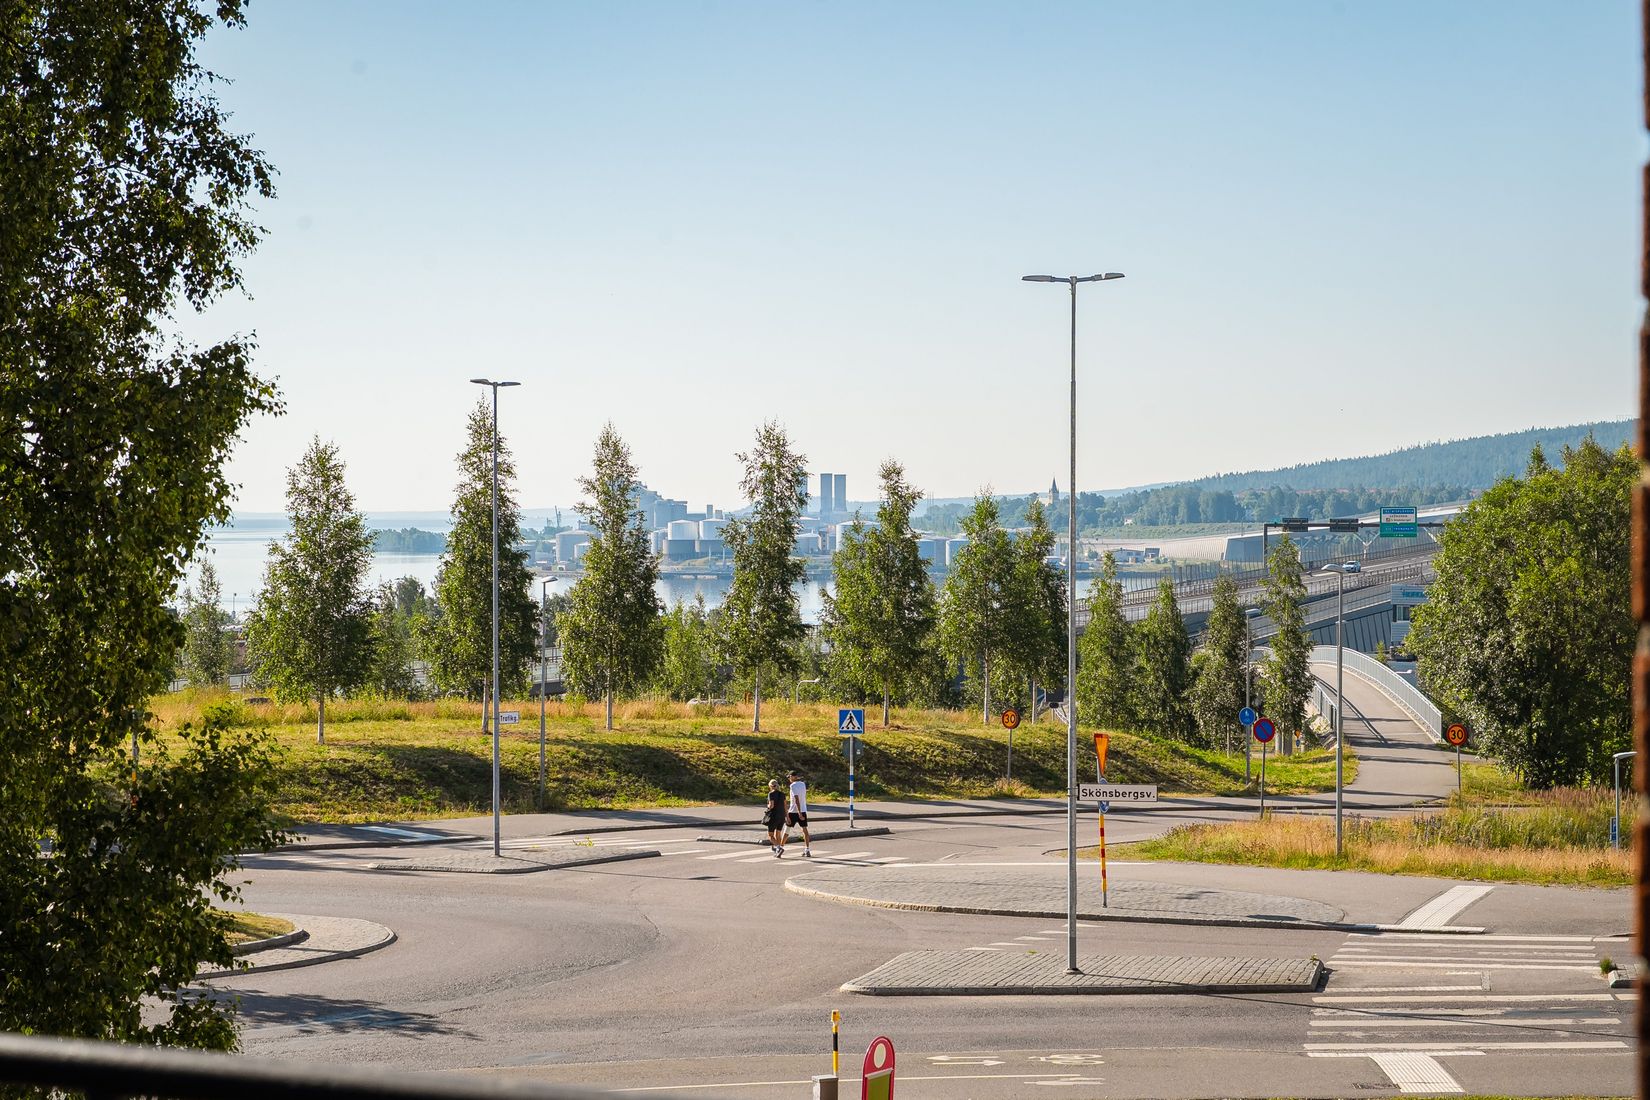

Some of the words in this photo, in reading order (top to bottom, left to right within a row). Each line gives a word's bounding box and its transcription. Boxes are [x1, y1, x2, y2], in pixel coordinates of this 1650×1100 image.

[1005, 714, 1016, 724] 30
[1451, 729, 1464, 740] 30
[1081, 788, 1156, 800] Skönsbergsv.
